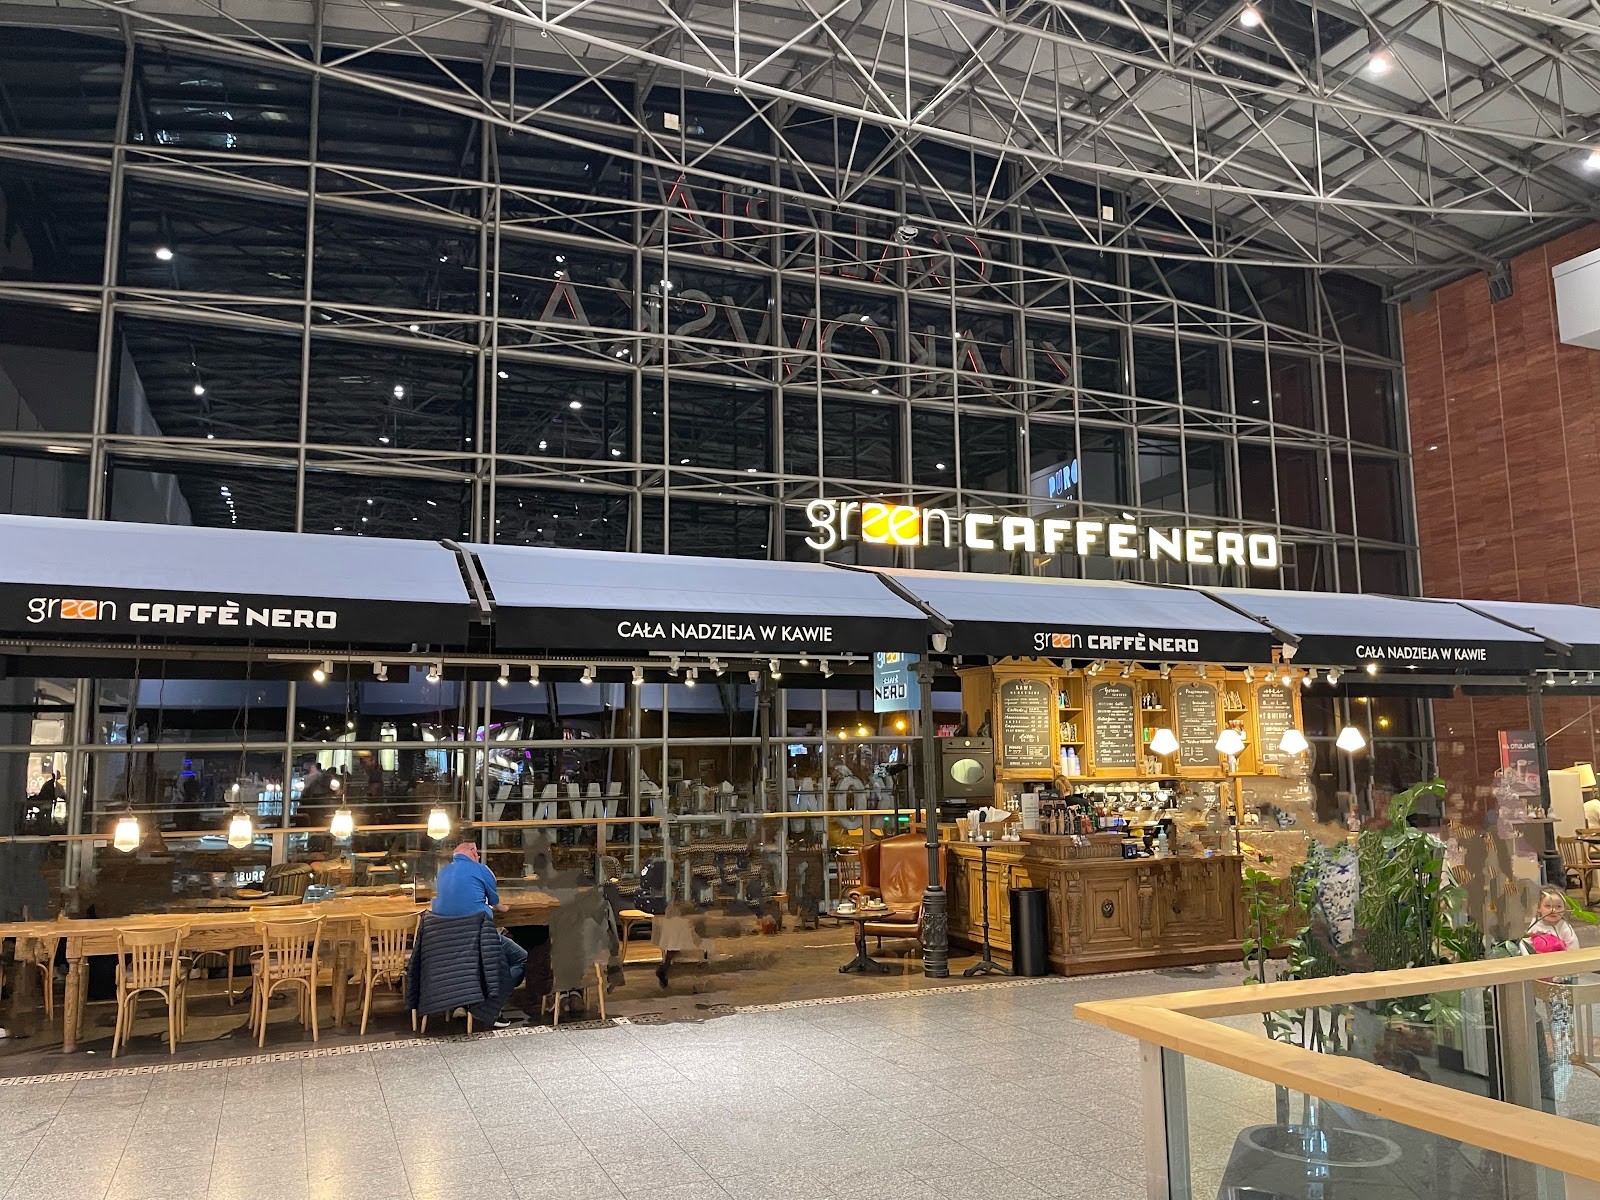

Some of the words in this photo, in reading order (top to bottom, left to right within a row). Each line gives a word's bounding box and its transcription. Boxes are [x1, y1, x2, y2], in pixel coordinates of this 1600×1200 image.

[1048, 458, 1079, 498] PURO
[804, 499, 951, 551] green
[965, 513, 1138, 559] CAFFÈ
[1149, 527, 1279, 568] NERO
[26, 597, 117, 624] green
[129, 600, 240, 626] CAFFÈ
[246, 607, 338, 629] NERO
[617, 621, 666, 638] CAŁA
[672, 623, 756, 641] NADZIEJA
[760, 625, 778, 640] W
[782, 626, 833, 642] KAWIE
[1034, 632, 1083, 651] green
[1088, 632, 1146, 650] CAFFÈ
[1149, 637, 1199, 653] NERO
[1356, 645, 1386, 659] CAŁA
[1388, 647, 1440, 660] NADZIEJA
[1441, 648, 1452, 660] W
[1455, 648, 1487, 661] KAWIE
[875, 683, 907, 701] NERO
